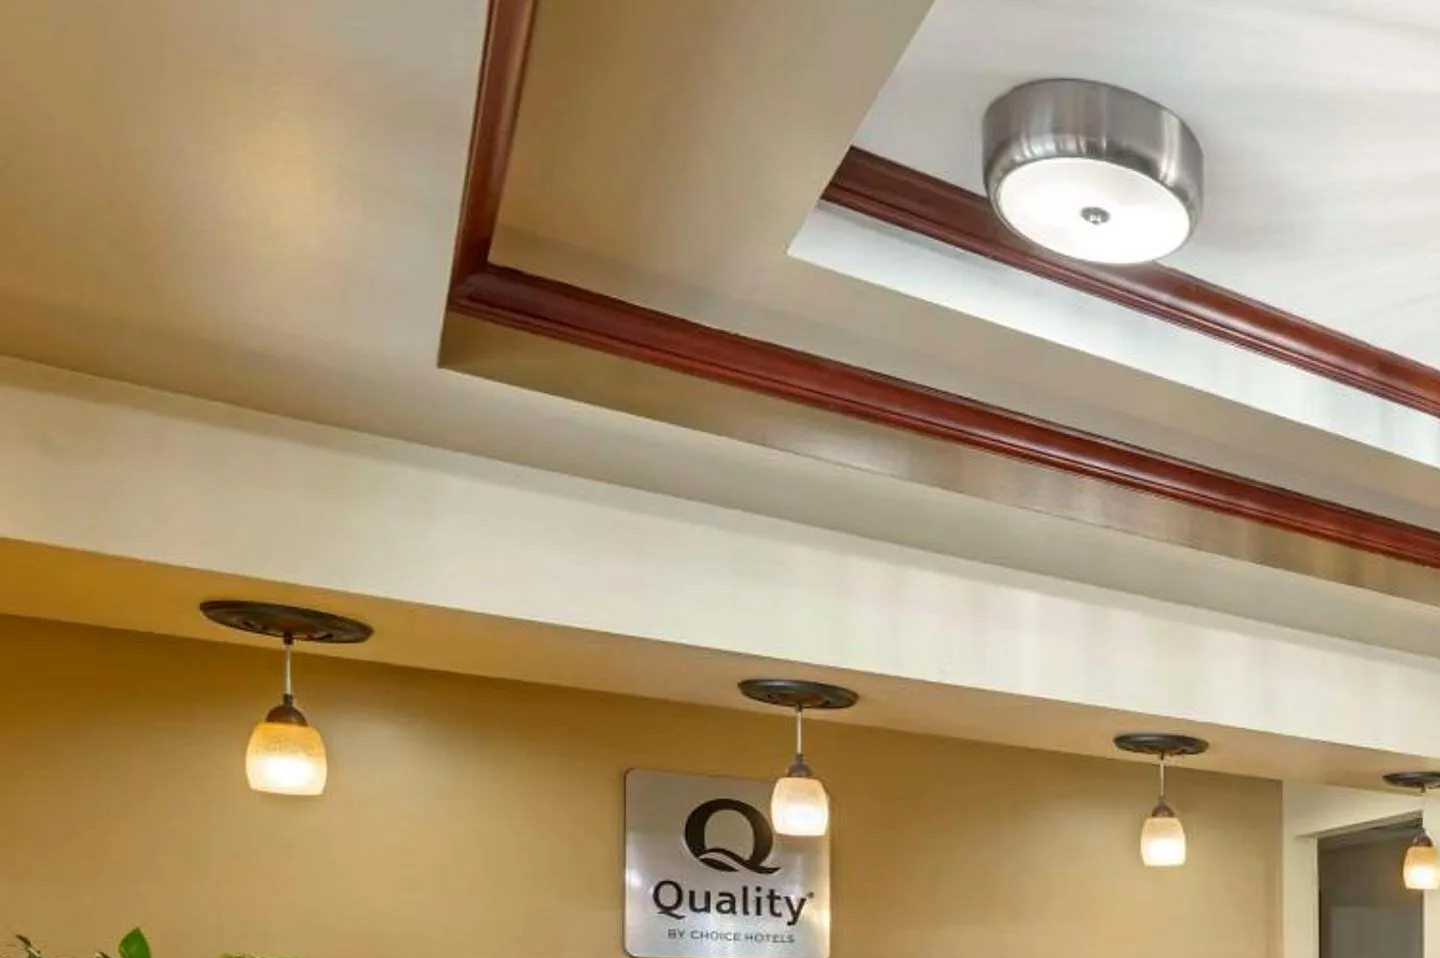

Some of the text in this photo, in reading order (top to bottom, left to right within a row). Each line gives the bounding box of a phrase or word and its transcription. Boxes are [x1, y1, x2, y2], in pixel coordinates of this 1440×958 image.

[684, 798, 781, 875] Q
[652, 880, 807, 926] Quality
[667, 928, 796, 944] BY CHOICE HOTELS
